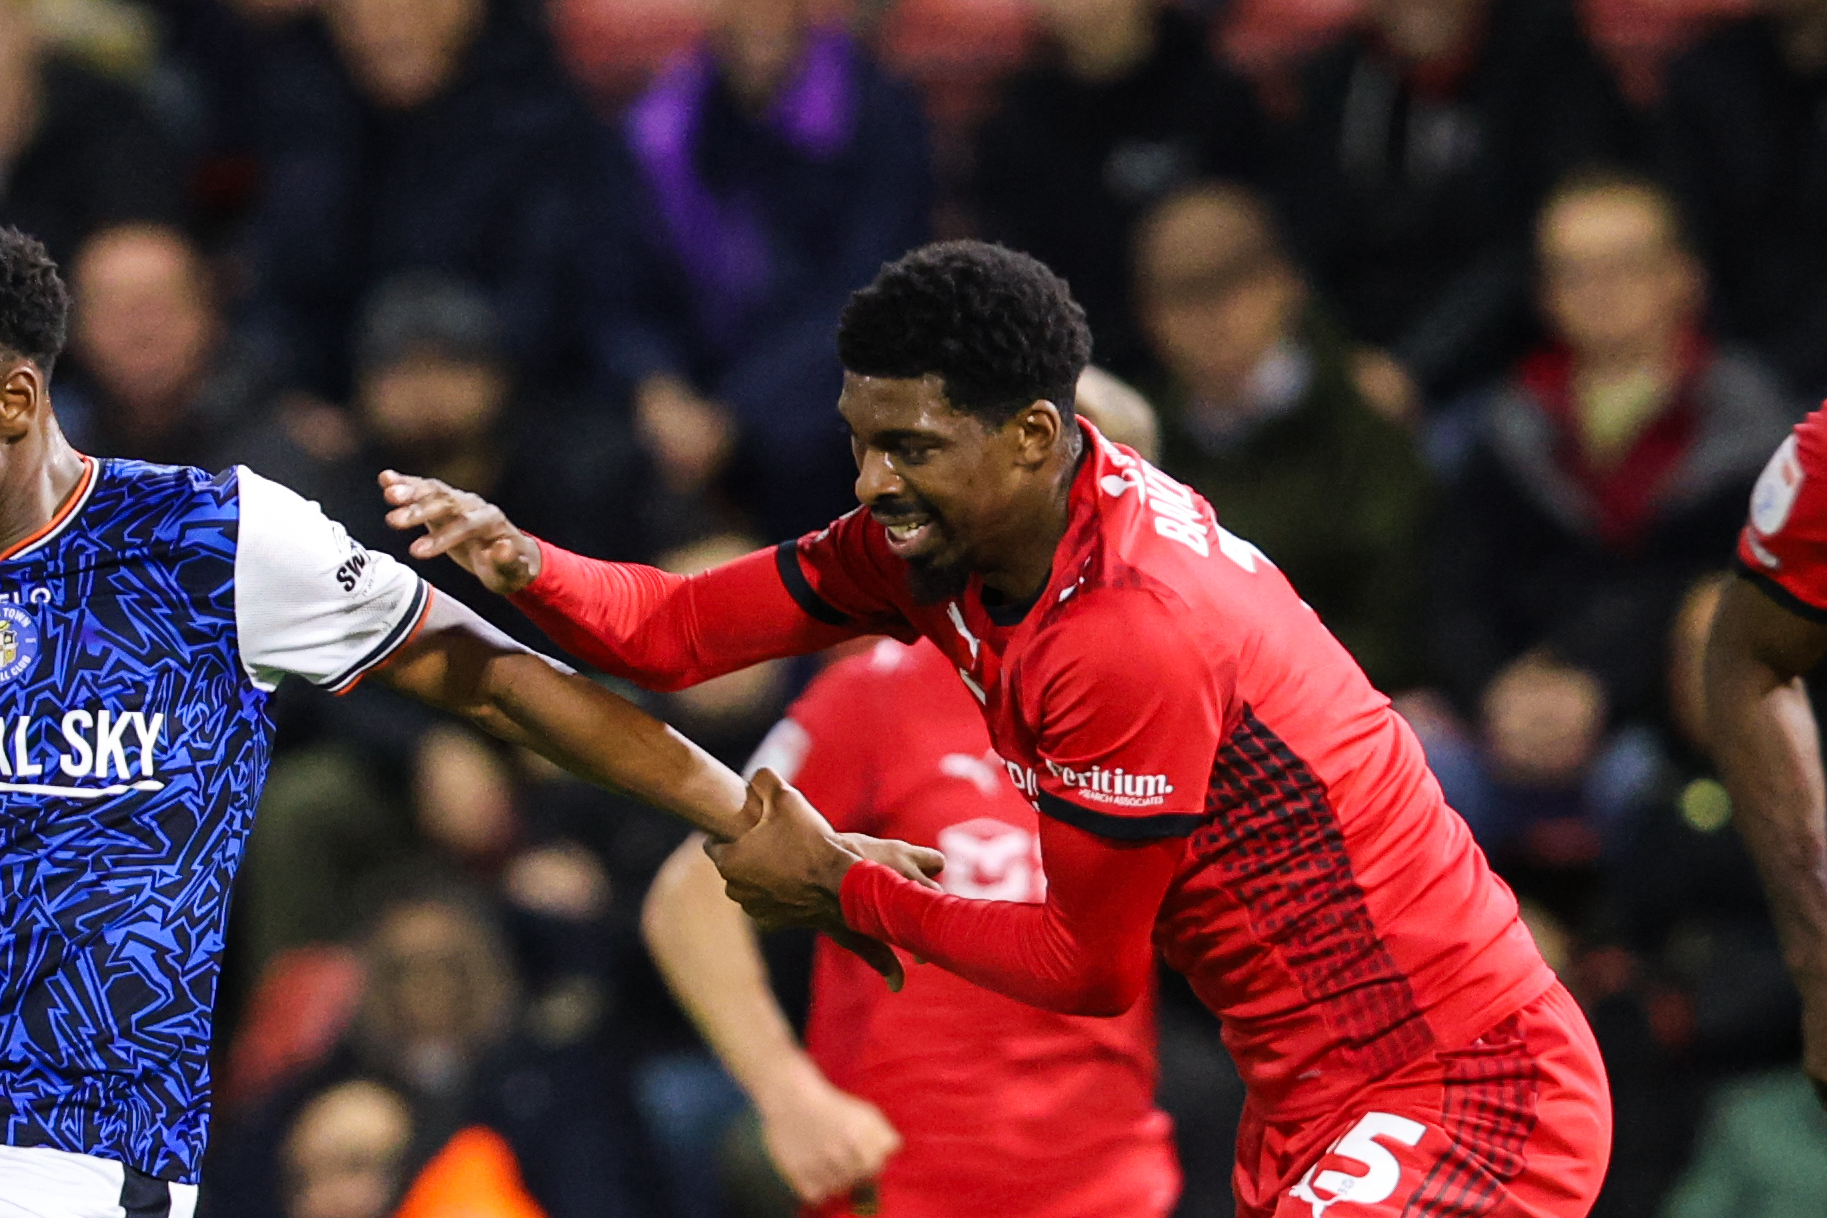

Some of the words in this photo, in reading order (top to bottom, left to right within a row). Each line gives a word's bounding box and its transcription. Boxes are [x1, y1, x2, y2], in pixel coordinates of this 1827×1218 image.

[2, 607, 32, 628] TOWN
[10, 655, 33, 676] CLUB
[59, 709, 165, 780] SKY
